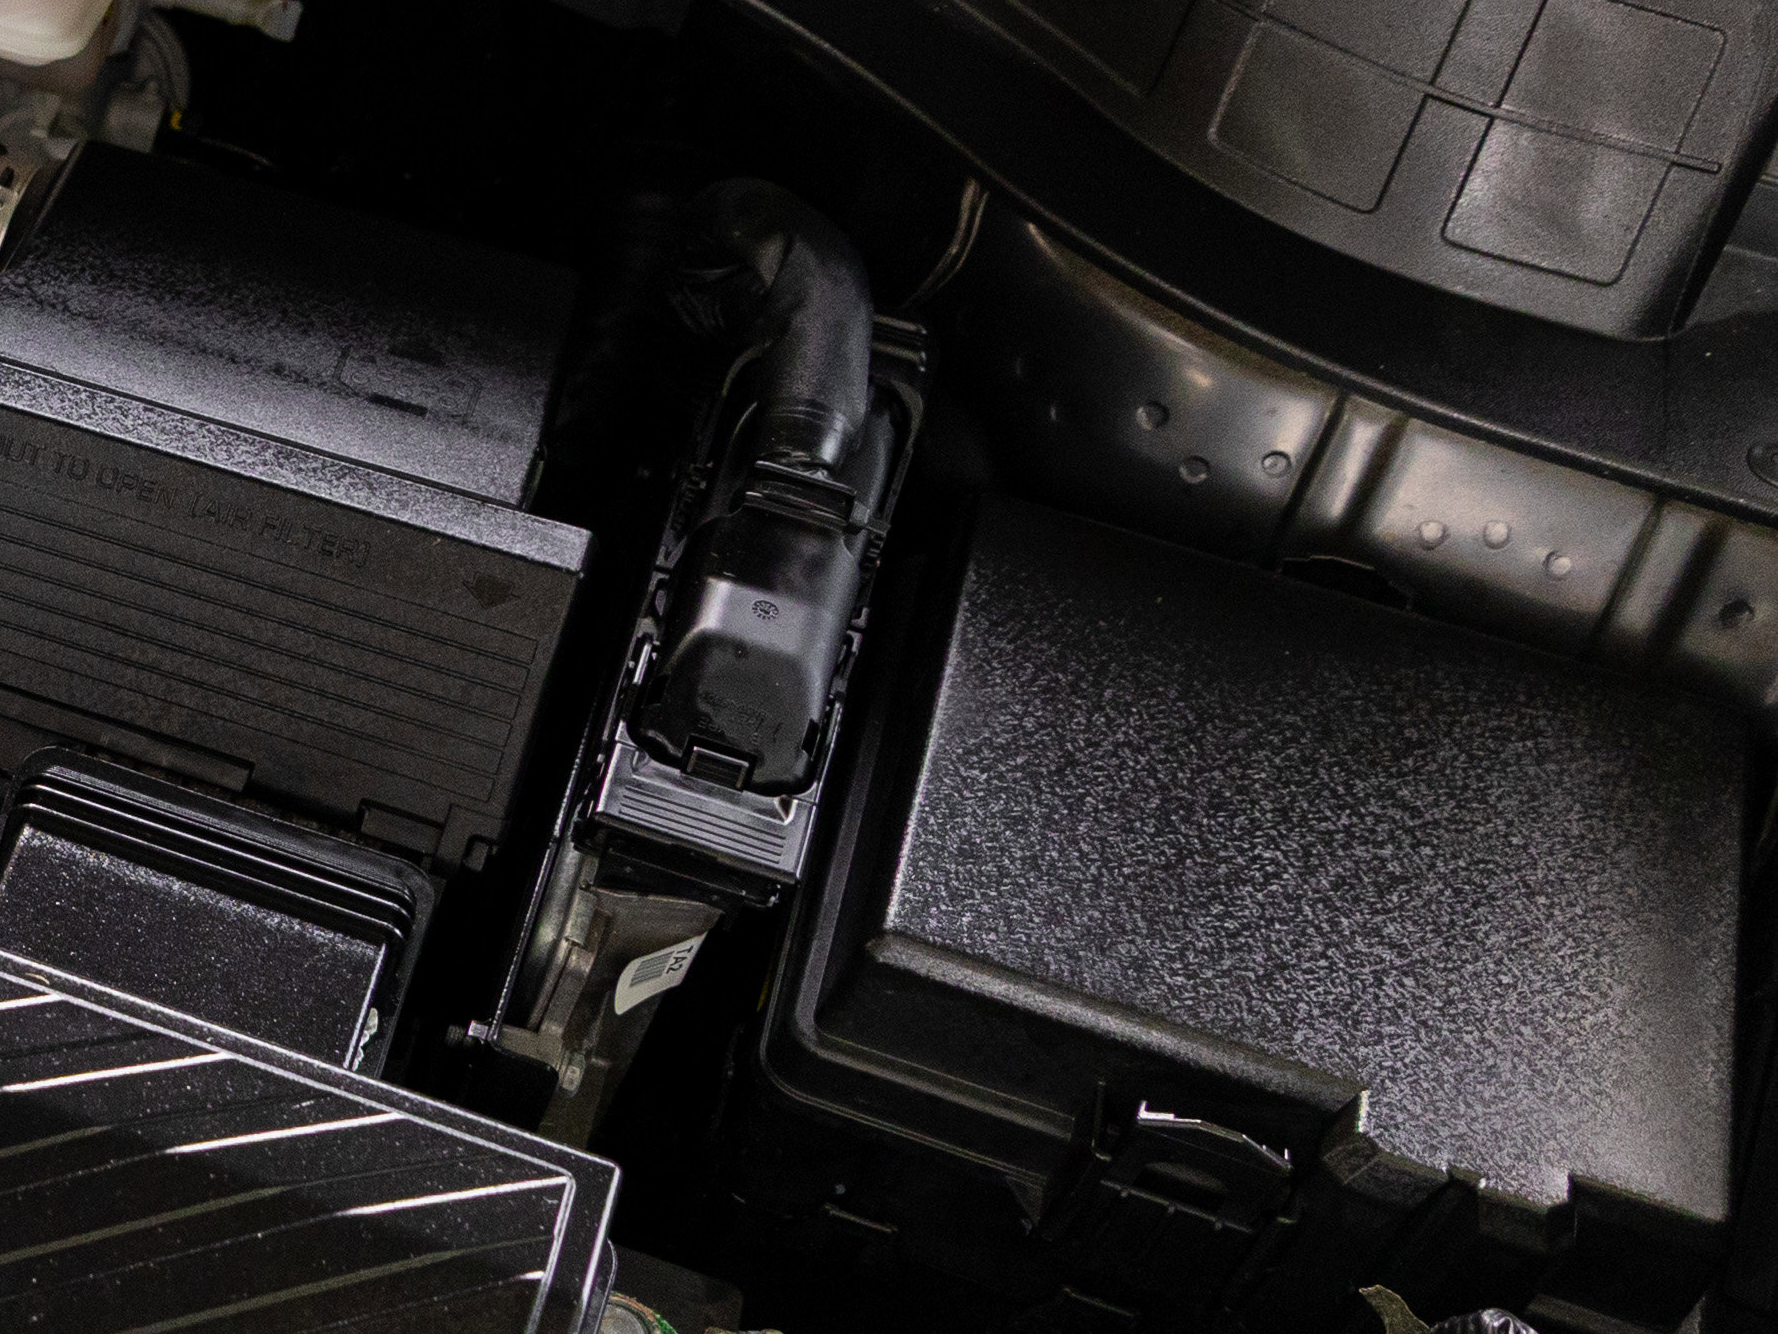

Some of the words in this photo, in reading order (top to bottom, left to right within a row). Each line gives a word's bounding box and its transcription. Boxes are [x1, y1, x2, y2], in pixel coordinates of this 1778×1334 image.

[47, 450, 90, 482] TO
[93, 463, 179, 509] OPEN
[666, 946, 693, 974] TA2
